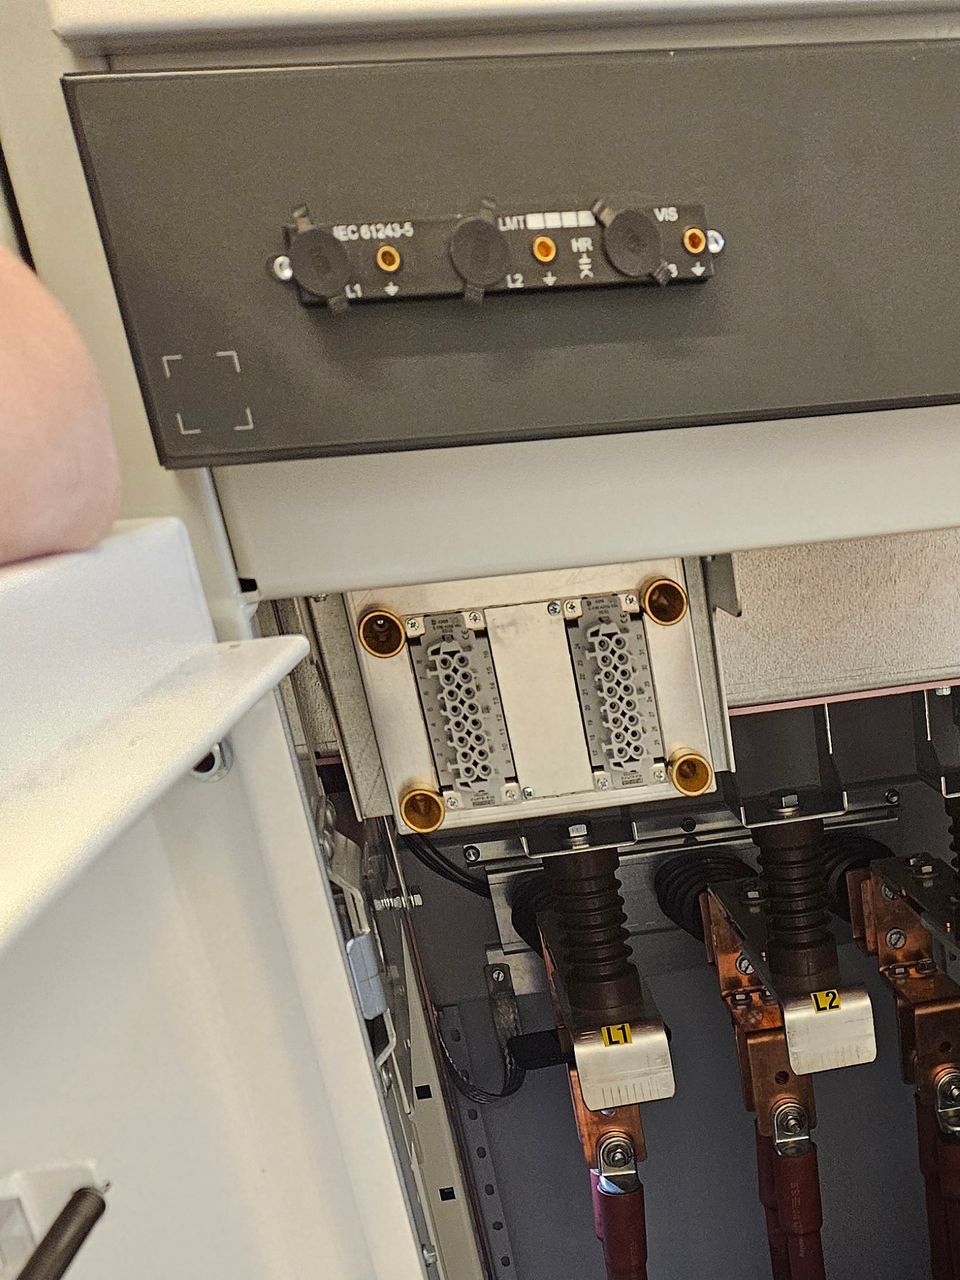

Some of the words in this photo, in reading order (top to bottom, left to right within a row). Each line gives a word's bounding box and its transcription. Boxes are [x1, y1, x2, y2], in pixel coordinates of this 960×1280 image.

[653, 206, 679, 222] VIS
[332, 224, 360, 242] IEC
[570, 237, 593, 253] HR
[506, 273, 525, 289] L2
[344, 283, 363, 299] L1
[813, 991, 840, 1011] L2
[606, 1024, 629, 1045] L1
